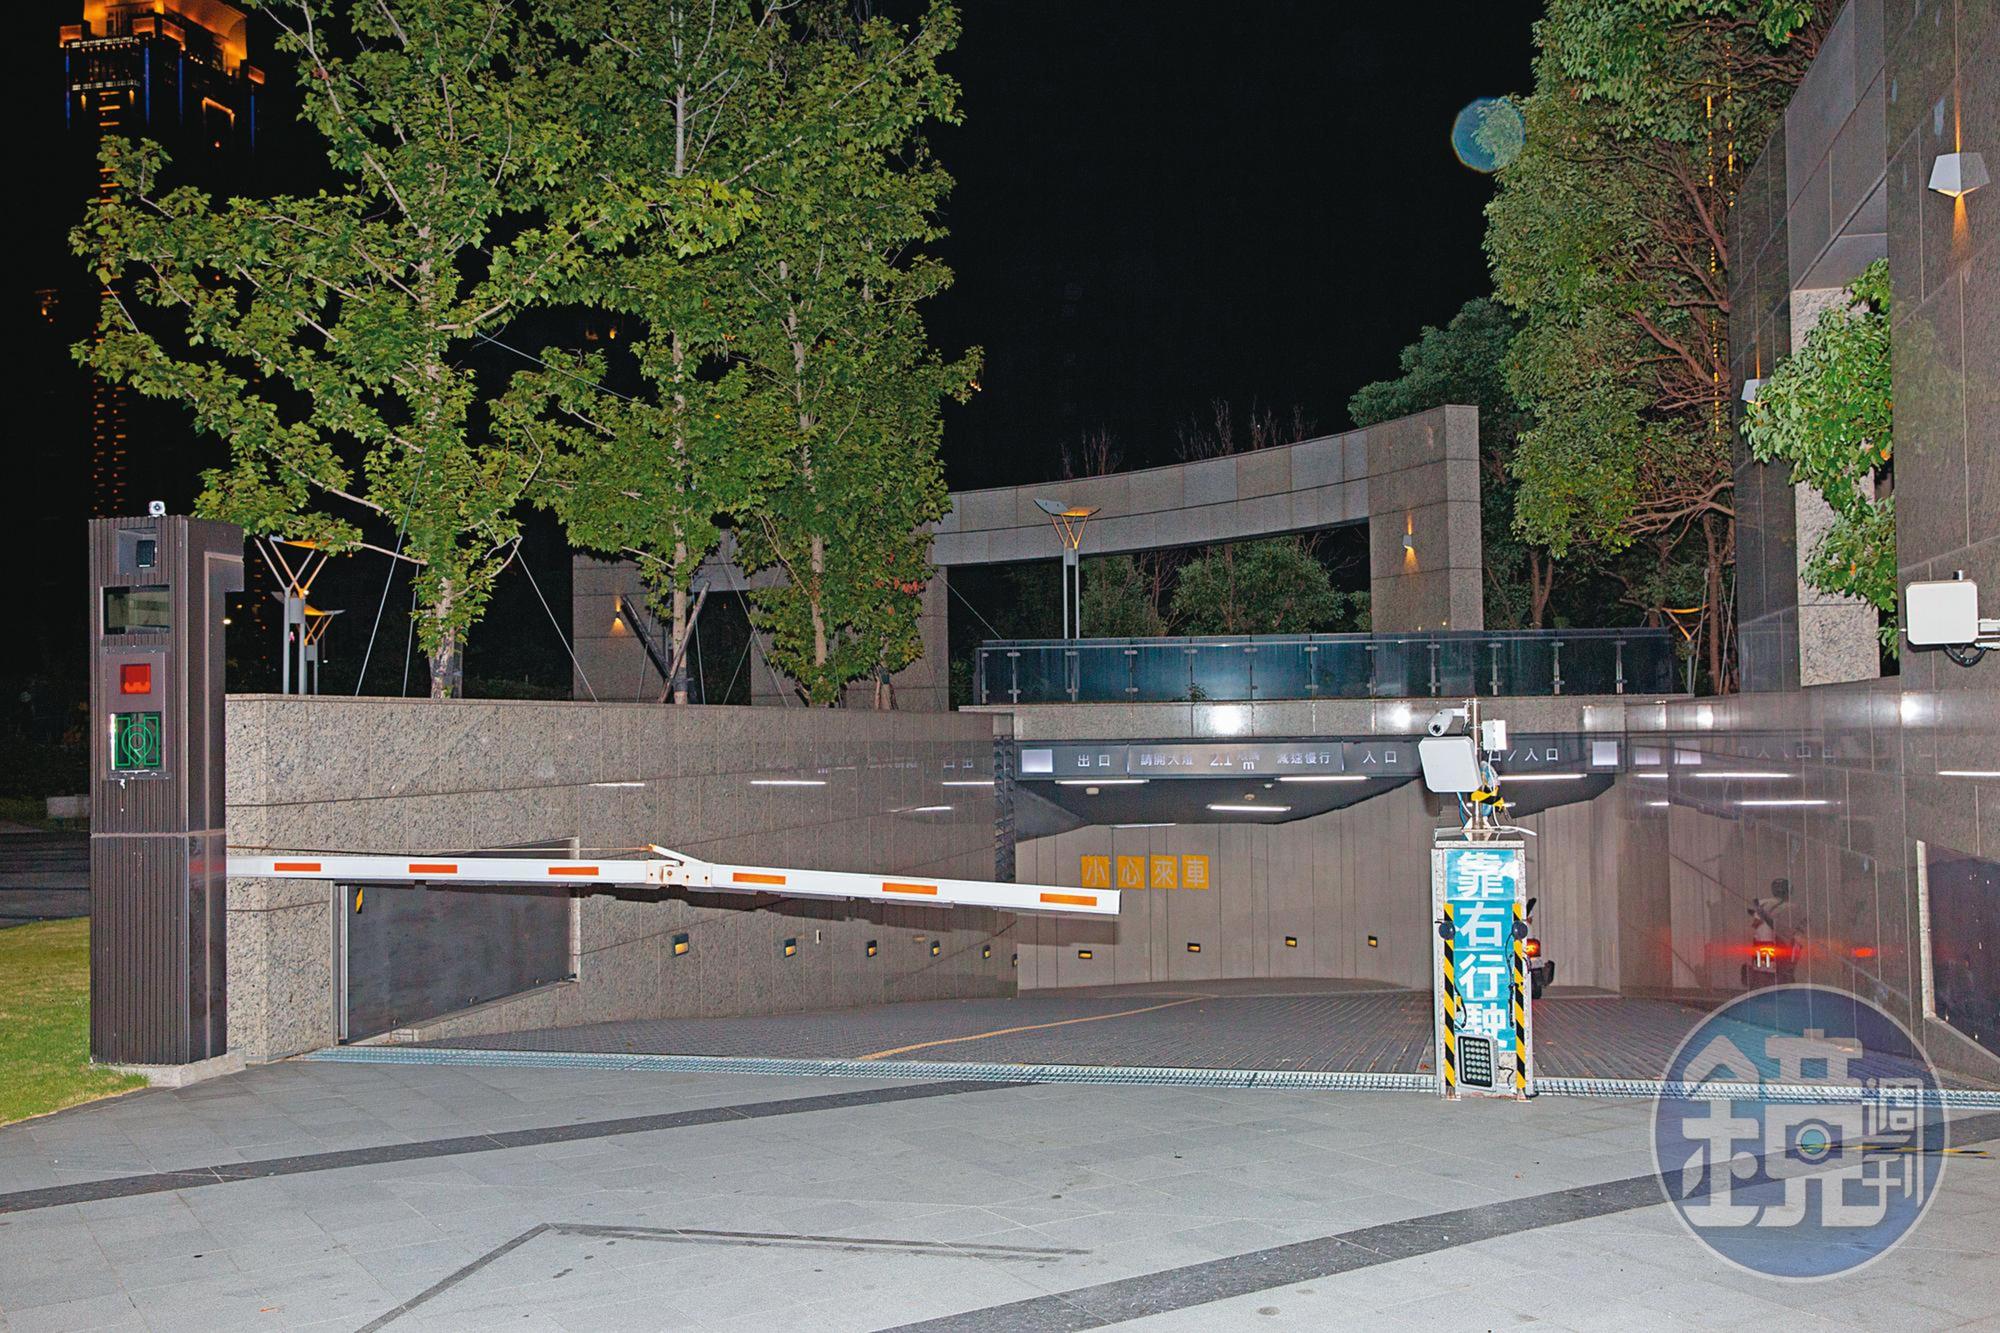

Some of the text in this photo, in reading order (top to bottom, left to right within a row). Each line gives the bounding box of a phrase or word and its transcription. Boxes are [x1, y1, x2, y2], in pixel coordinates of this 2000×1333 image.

[1078, 754, 1110, 767] 出口
[1210, 752, 1233, 767] 2.1
[1363, 750, 1397, 764] 入口
[1086, 858, 1205, 887] 小心來車
